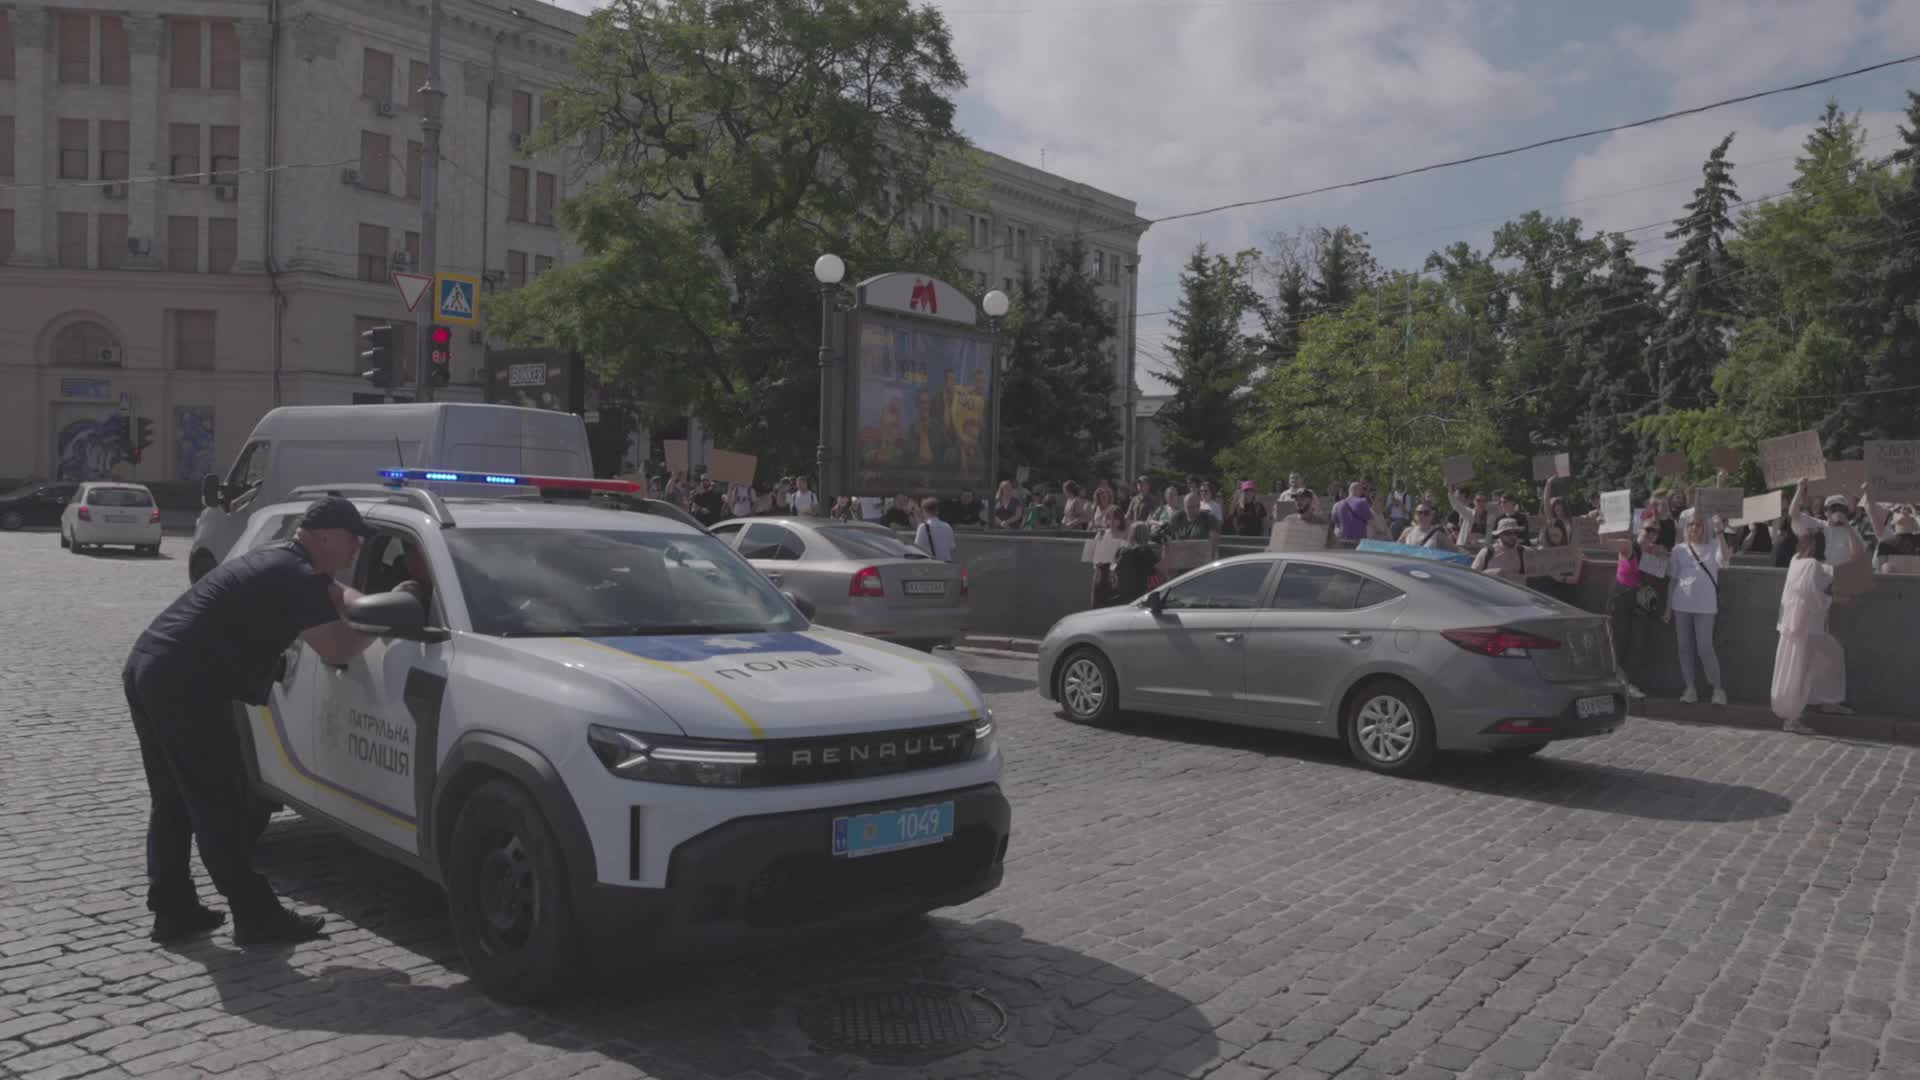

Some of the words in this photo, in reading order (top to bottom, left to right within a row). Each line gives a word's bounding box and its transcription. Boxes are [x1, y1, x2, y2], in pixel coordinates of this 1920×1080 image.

[511, 366, 544, 384] BUNKER
[714, 655, 873, 680] ПОЛІЦІЯ
[348, 707, 409, 745] ПАТРУЛЬНА
[347, 732, 410, 777] ПОЛІЦІЯ
[791, 733, 961, 766] RENAULT
[896, 808, 940, 840] 1049
